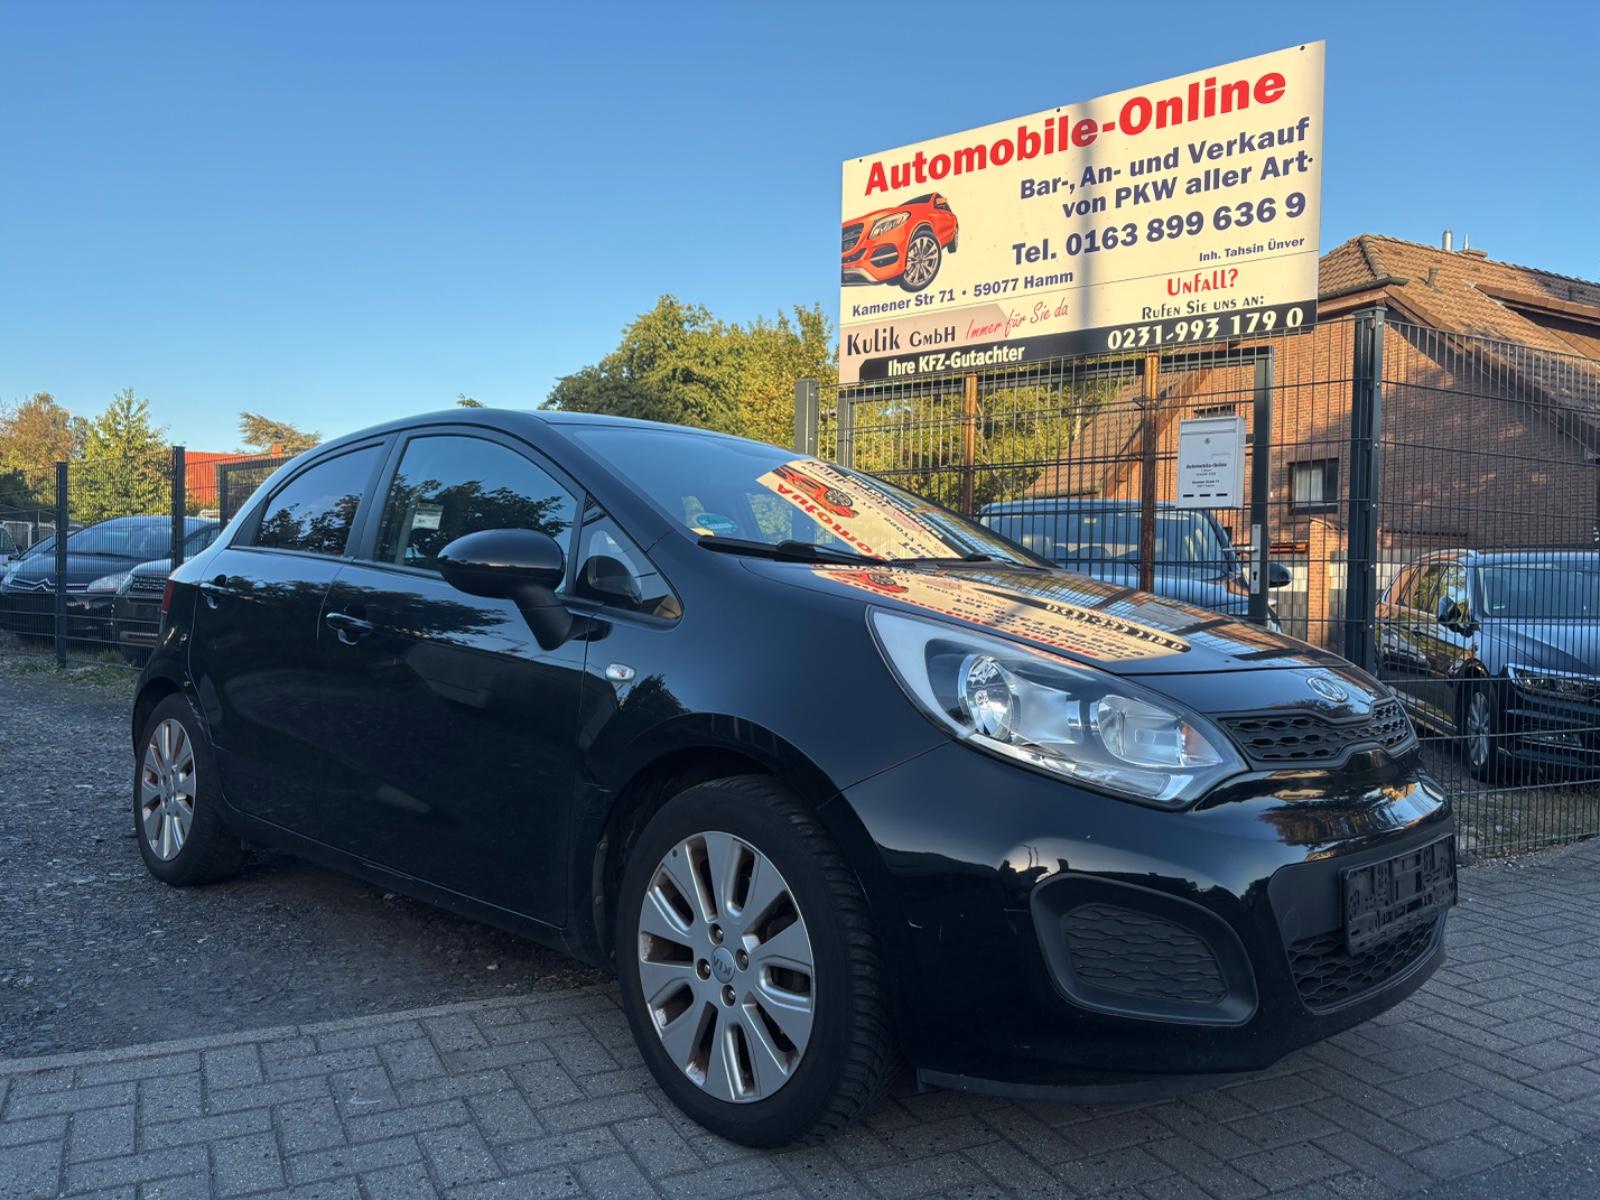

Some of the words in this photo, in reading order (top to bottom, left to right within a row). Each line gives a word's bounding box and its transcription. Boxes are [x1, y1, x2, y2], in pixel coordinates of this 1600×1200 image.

[864, 72, 1286, 196] Automobile-Online
[1020, 176, 1075, 200] Bar-,
[1080, 165, 1121, 188] An-
[1130, 146, 1179, 177] und
[1188, 116, 1310, 164] Verkauf
[1062, 196, 1106, 218] von
[1115, 176, 1178, 209] PKW
[1185, 166, 1252, 195] aller
[1012, 238, 1057, 265] Tel.
[1065, 222, 1138, 256] 0163
[1146, 210, 1204, 243] 899
[1212, 197, 1276, 231] 636
[1285, 191, 1306, 218] 9
[1199, 252, 1221, 262] Inh.
[1224, 243, 1264, 258] Tahsin
[1267, 237, 1305, 251] Ünver
[852, 298, 911, 318] Kamener
[914, 293, 935, 308] Str
[939, 288, 955, 303] 71
[973, 278, 1019, 298] 59077
[1023, 271, 1073, 289] Hamm
[1186, 299, 1207, 315] Sie
[846, 325, 900, 357] Kulik
[965, 319, 1002, 341] Immer
[1002, 309, 1027, 338] für
[1030, 300, 1051, 325] Sie
[1054, 297, 1069, 318] da
[1107, 316, 1220, 350] 0231-993
[1230, 310, 1277, 336] 179
[1286, 307, 1304, 328] 0
[887, 359, 916, 377] Ihre
[918, 345, 1026, 371] KFZ-Gutachter
